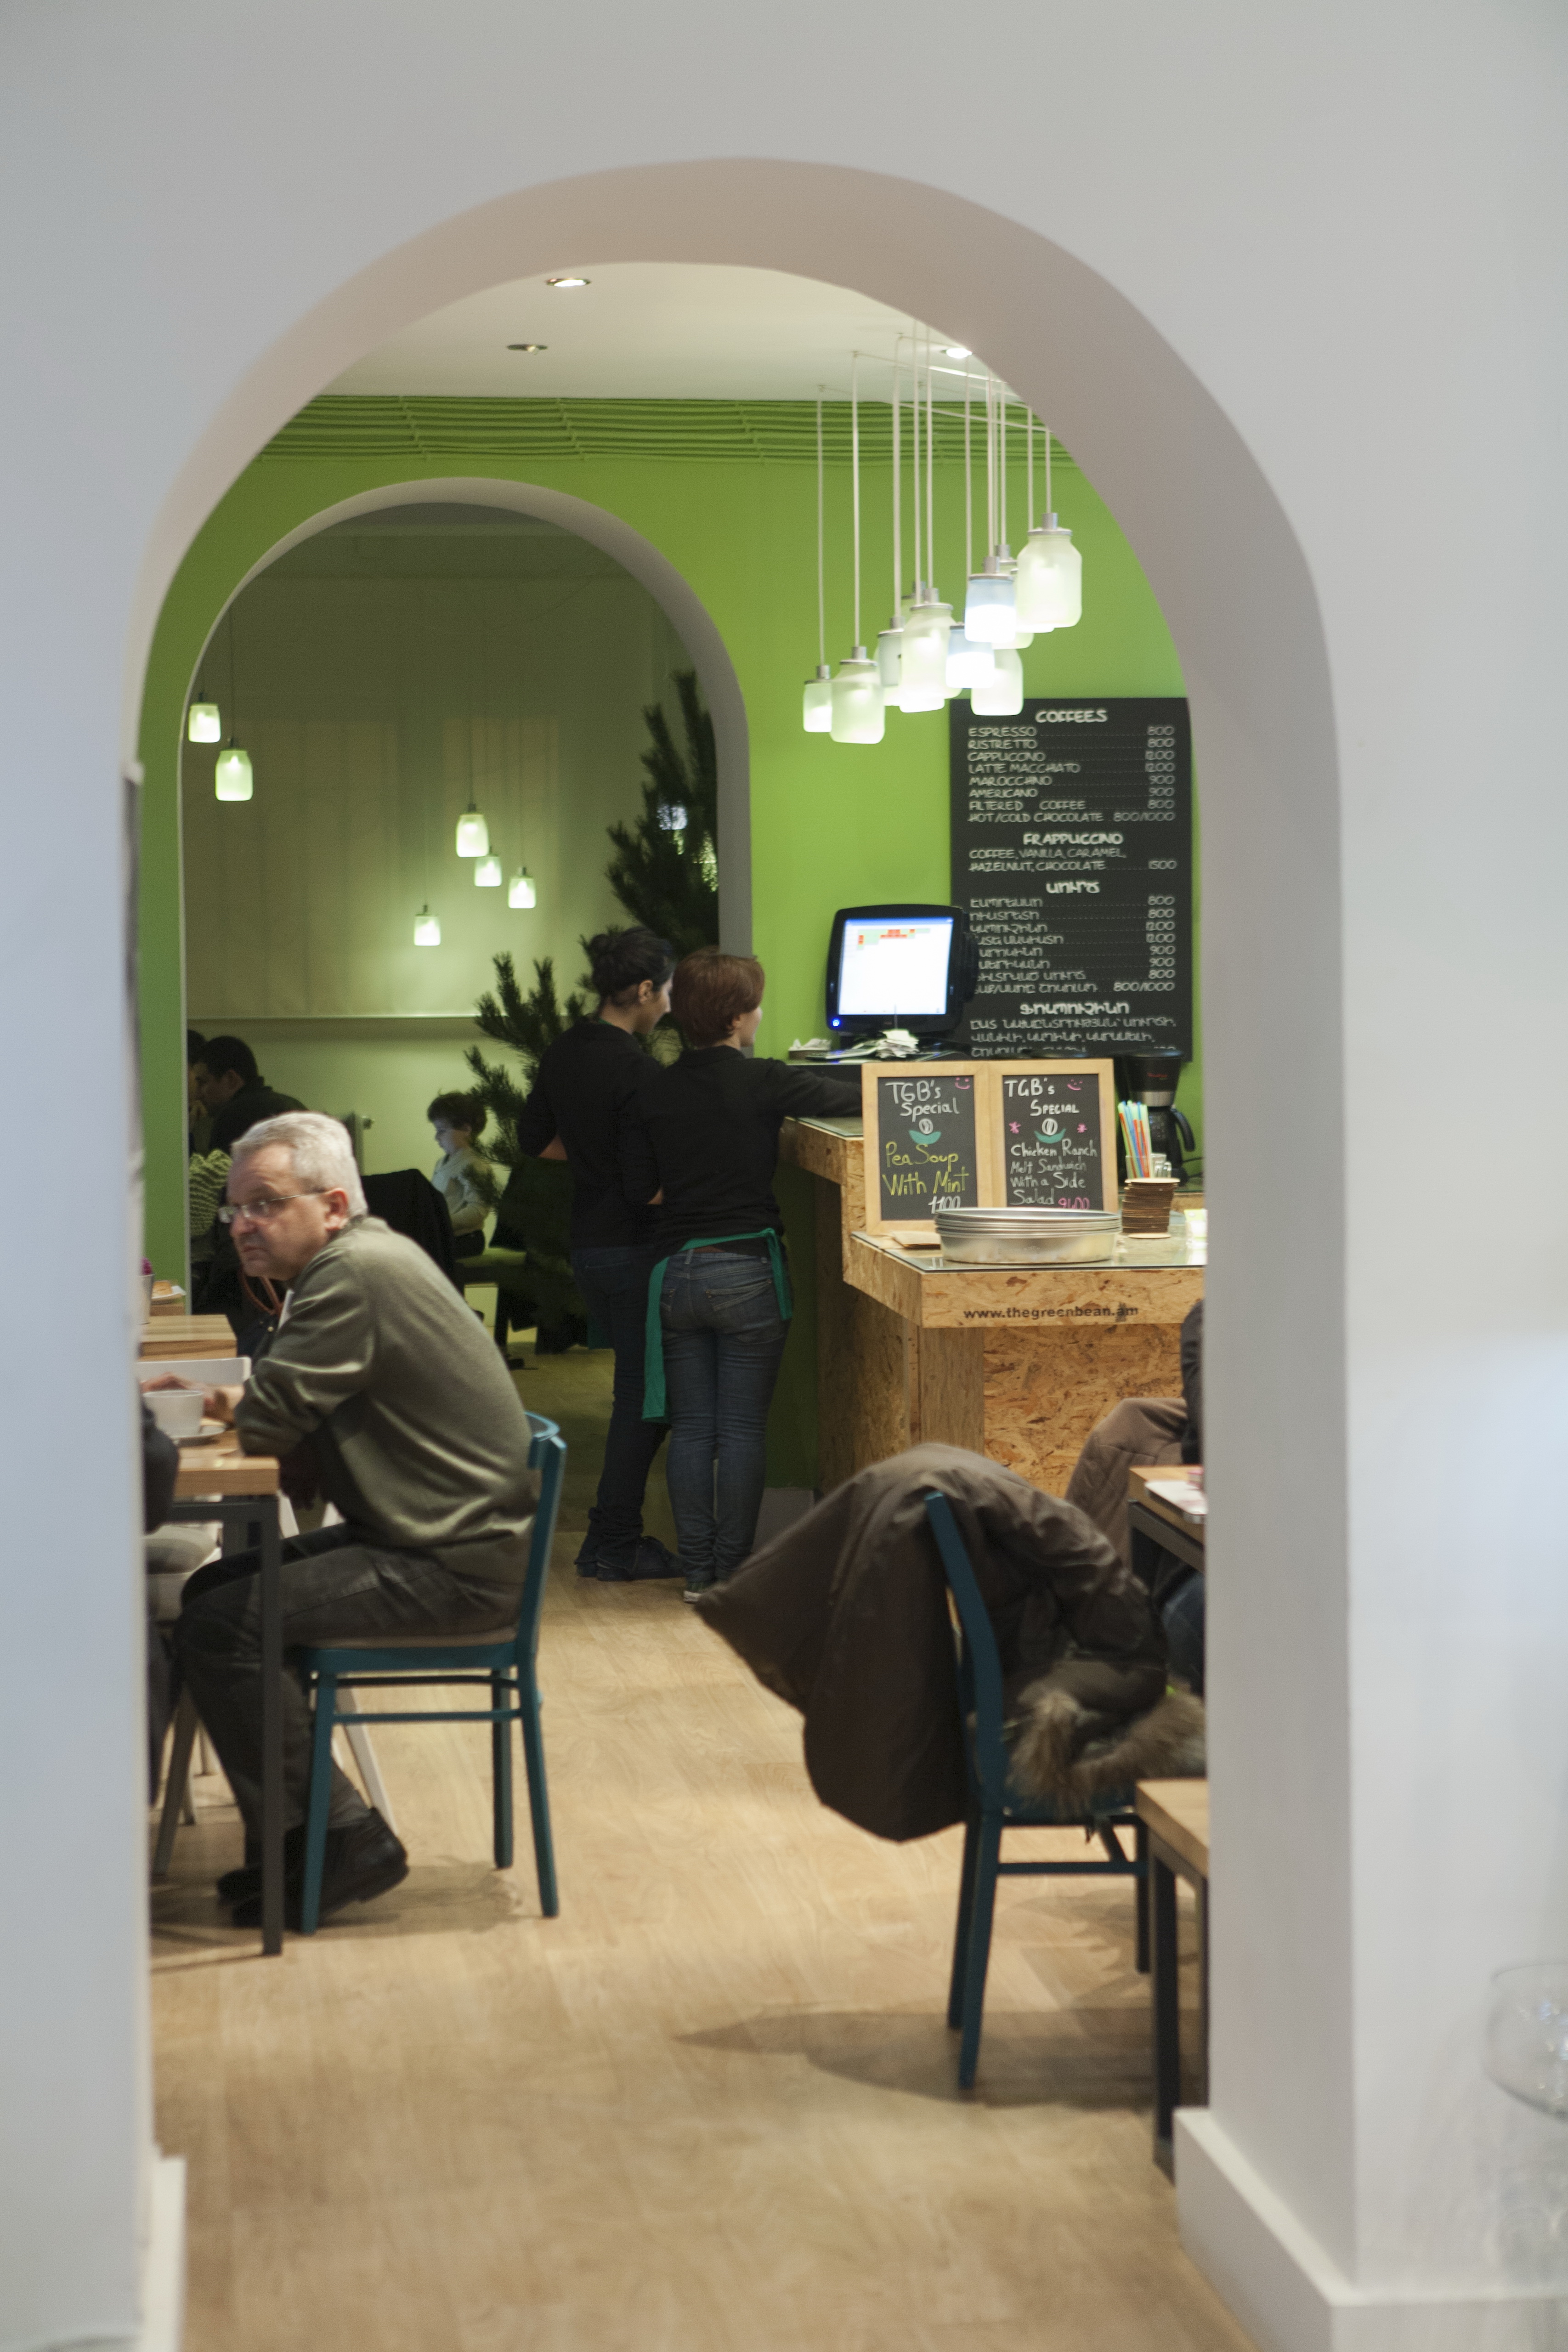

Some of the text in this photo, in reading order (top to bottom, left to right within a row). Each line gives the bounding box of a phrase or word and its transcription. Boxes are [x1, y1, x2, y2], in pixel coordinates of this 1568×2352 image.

[1035, 710, 1108, 723] COFFEES
[968, 727, 1037, 737] ESPRESSO
[968, 738, 1175, 749] RISTRETTO 800
[967, 752, 1047, 762] CAPPUCCINO
[968, 764, 1007, 774] LATTE
[1009, 763, 1081, 773] MACCHIATO
[1149, 775, 1175, 785] 900
[968, 787, 1175, 798] AMERICANO 900
[968, 800, 1175, 811] FILTERED COFFEE 800
[1033, 812, 1104, 822] CHOCOLATE
[1023, 832, 1124, 846] FRAPPUCCINO
[1036, 860, 1106, 871] CHOCOLATE
[1149, 946, 1176, 956] 900
[1149, 958, 1175, 967] 900
[885, 1080, 941, 1104] TGB's
[900, 1097, 960, 1122] Special
[1010, 1138, 1098, 1157] Chicken Ranch
[885, 1141, 959, 1172] Pea Soup
[1010, 1155, 1087, 1174] Melt Sandwich
[882, 1166, 969, 1196] With Mint
[1010, 1175, 1039, 1187] With
[1053, 1171, 1087, 1188] Side
[1011, 1188, 1054, 1205] Salad
[964, 1305, 1138, 1320] www.thegreenbean.am
